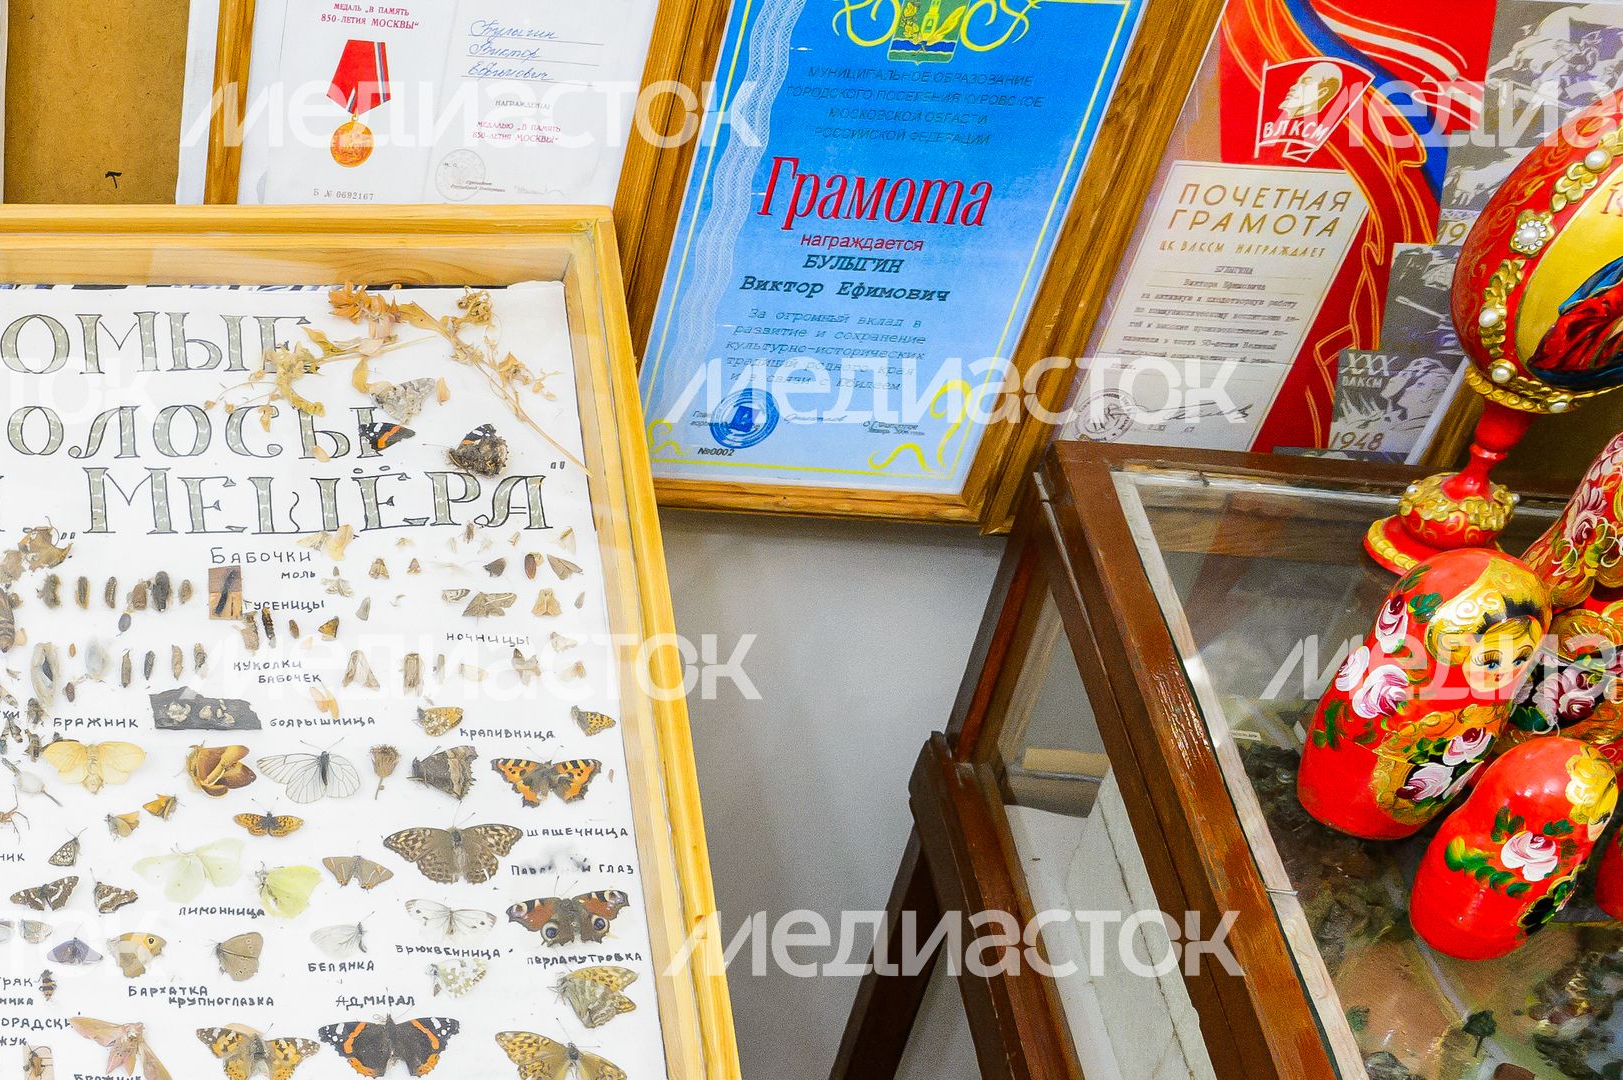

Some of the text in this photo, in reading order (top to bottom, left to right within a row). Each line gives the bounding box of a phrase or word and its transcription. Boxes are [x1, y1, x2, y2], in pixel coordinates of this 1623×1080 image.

[333, 3, 410, 17] МЕДАЛЬ ПАМЯТЬ
[1263, 119, 1330, 141] ВЛКСМ
[756, 156, 994, 231] Грамота
[1178, 183, 1353, 213] ПОЧЕТНАЯ
[1167, 208, 1341, 238] ГРАМОТА
[800, 233, 924, 251] награждается
[802, 254, 905, 273] БУЛЫГИН
[739, 275, 951, 302] Виктор Ефимович
[1330, 431, 1385, 450] 1948
[243, 599, 327, 614] ГУСЕНИЦЫ
[446, 633, 530, 648] НОЧНИЦЫ
[53, 716, 140, 731] БРАЖНИК
[526, 826, 629, 839] ШАШЕЧНИЦА
[598, 863, 634, 876] ГЛАЗ
[308, 961, 375, 973] БЕЛЯНКА
[335, 994, 416, 1011] АДМИРАЛ
